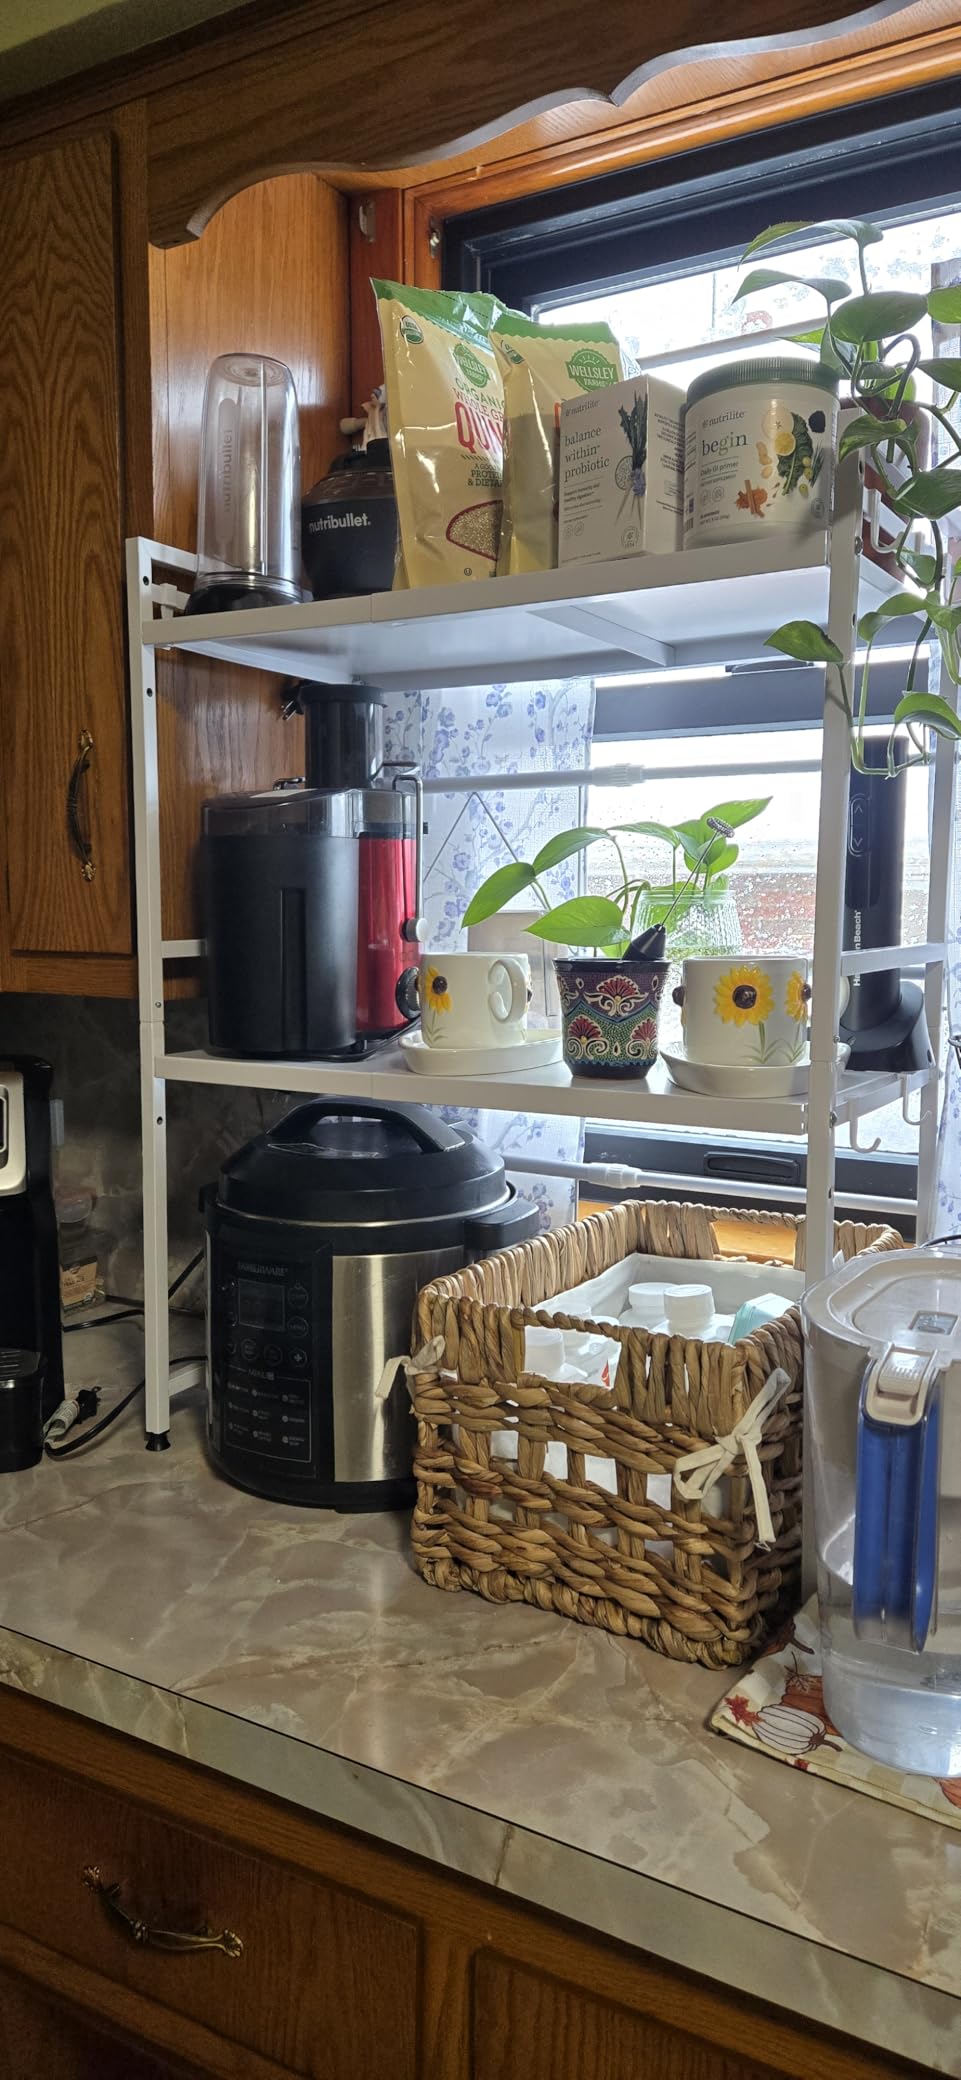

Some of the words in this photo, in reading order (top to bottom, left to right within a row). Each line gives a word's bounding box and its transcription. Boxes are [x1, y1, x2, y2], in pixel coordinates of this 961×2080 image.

[569, 365, 614, 379] WELLSLEY
[571, 400, 600, 415] nutrilite
[709, 410, 745, 427] nutrilite
[564, 427, 602, 446] balance
[702, 432, 748, 456] begin
[564, 457, 610, 482] probiotic
[854, 911, 862, 943] Beach
